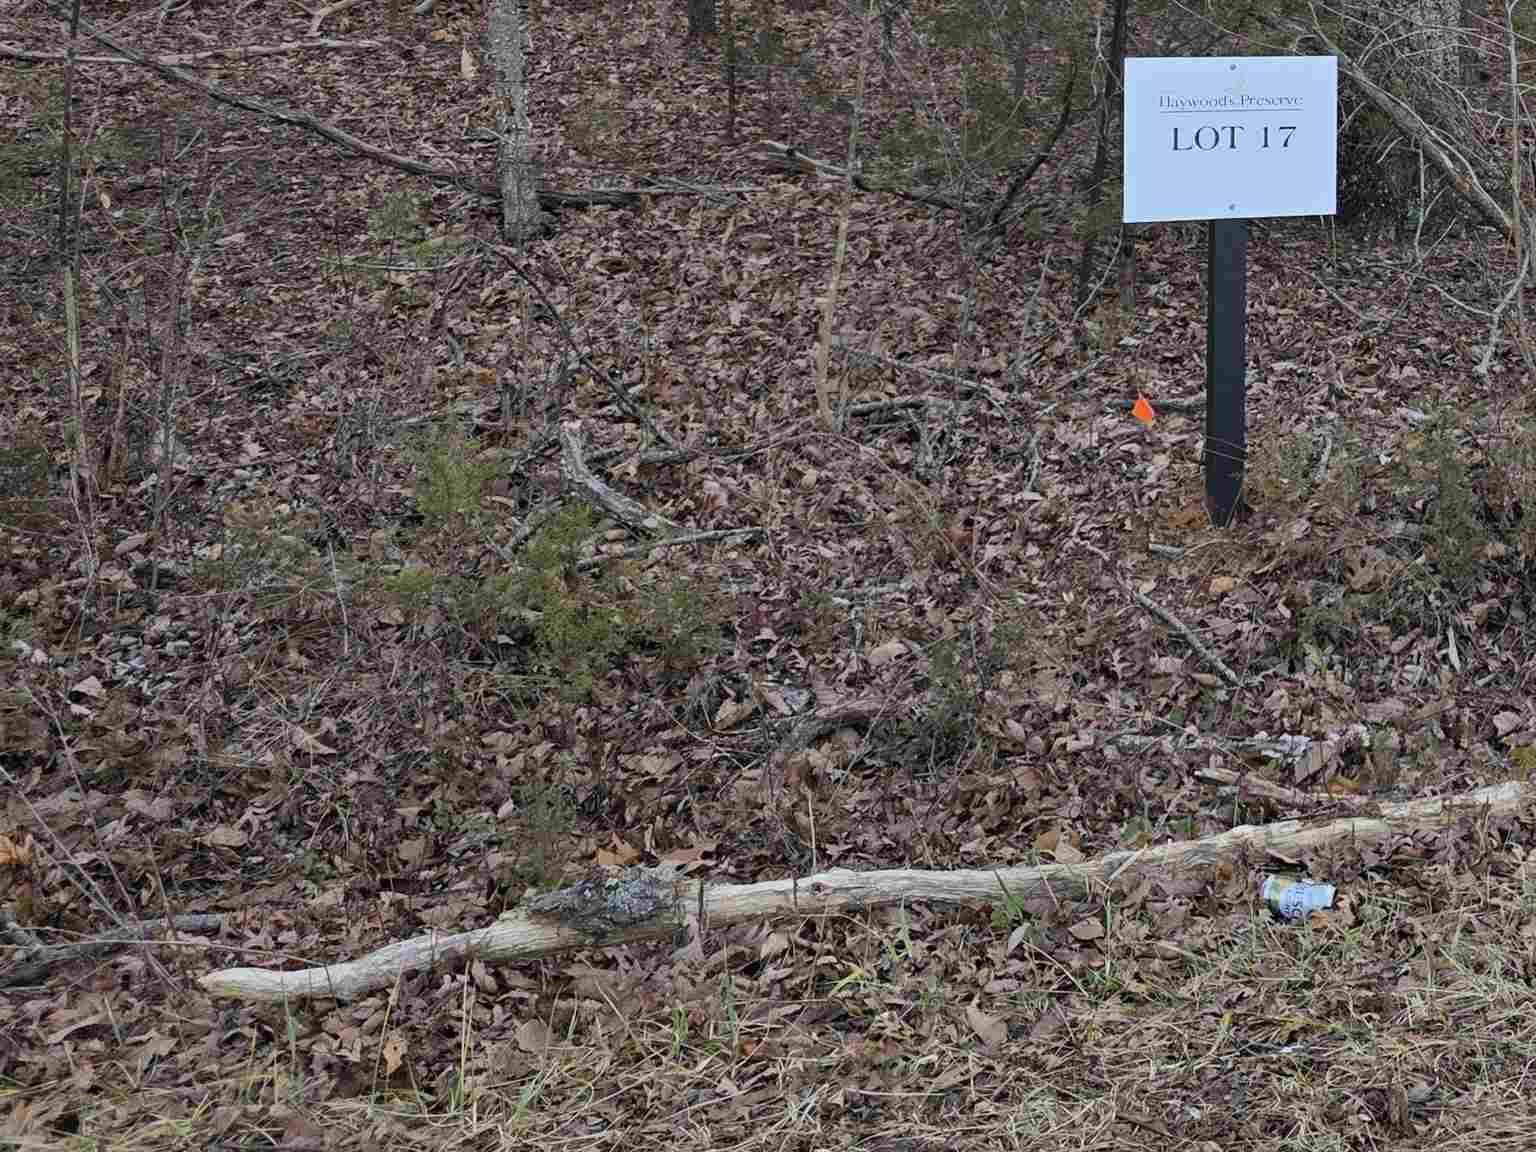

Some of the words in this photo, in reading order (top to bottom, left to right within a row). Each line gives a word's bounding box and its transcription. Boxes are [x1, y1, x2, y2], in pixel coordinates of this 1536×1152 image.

[1239, 94, 1304, 108] Preserve
[1172, 125, 1245, 151] LOT
[1261, 125, 1297, 149] 17
